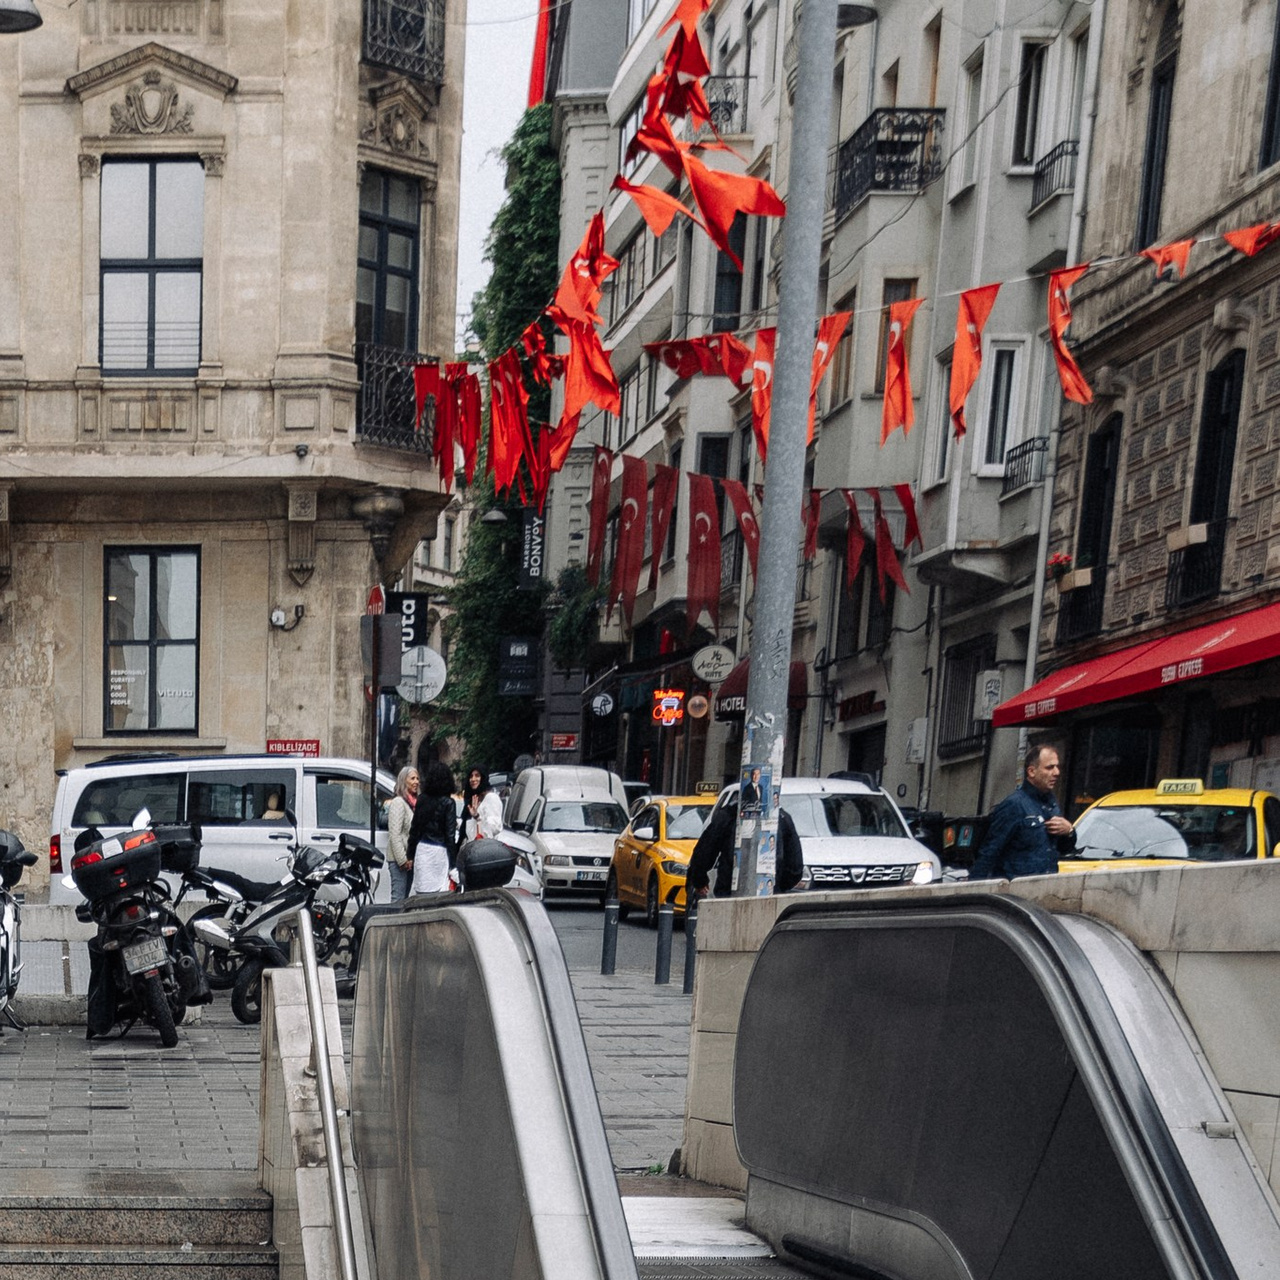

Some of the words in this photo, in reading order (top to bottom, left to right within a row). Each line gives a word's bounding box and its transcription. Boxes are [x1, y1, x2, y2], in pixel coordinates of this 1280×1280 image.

[523, 524, 532, 568] MARRIOTT
[529, 516, 543, 576] BONVOY
[157, 689, 194, 698] vitruta
[720, 697, 746, 712] HOTEL
